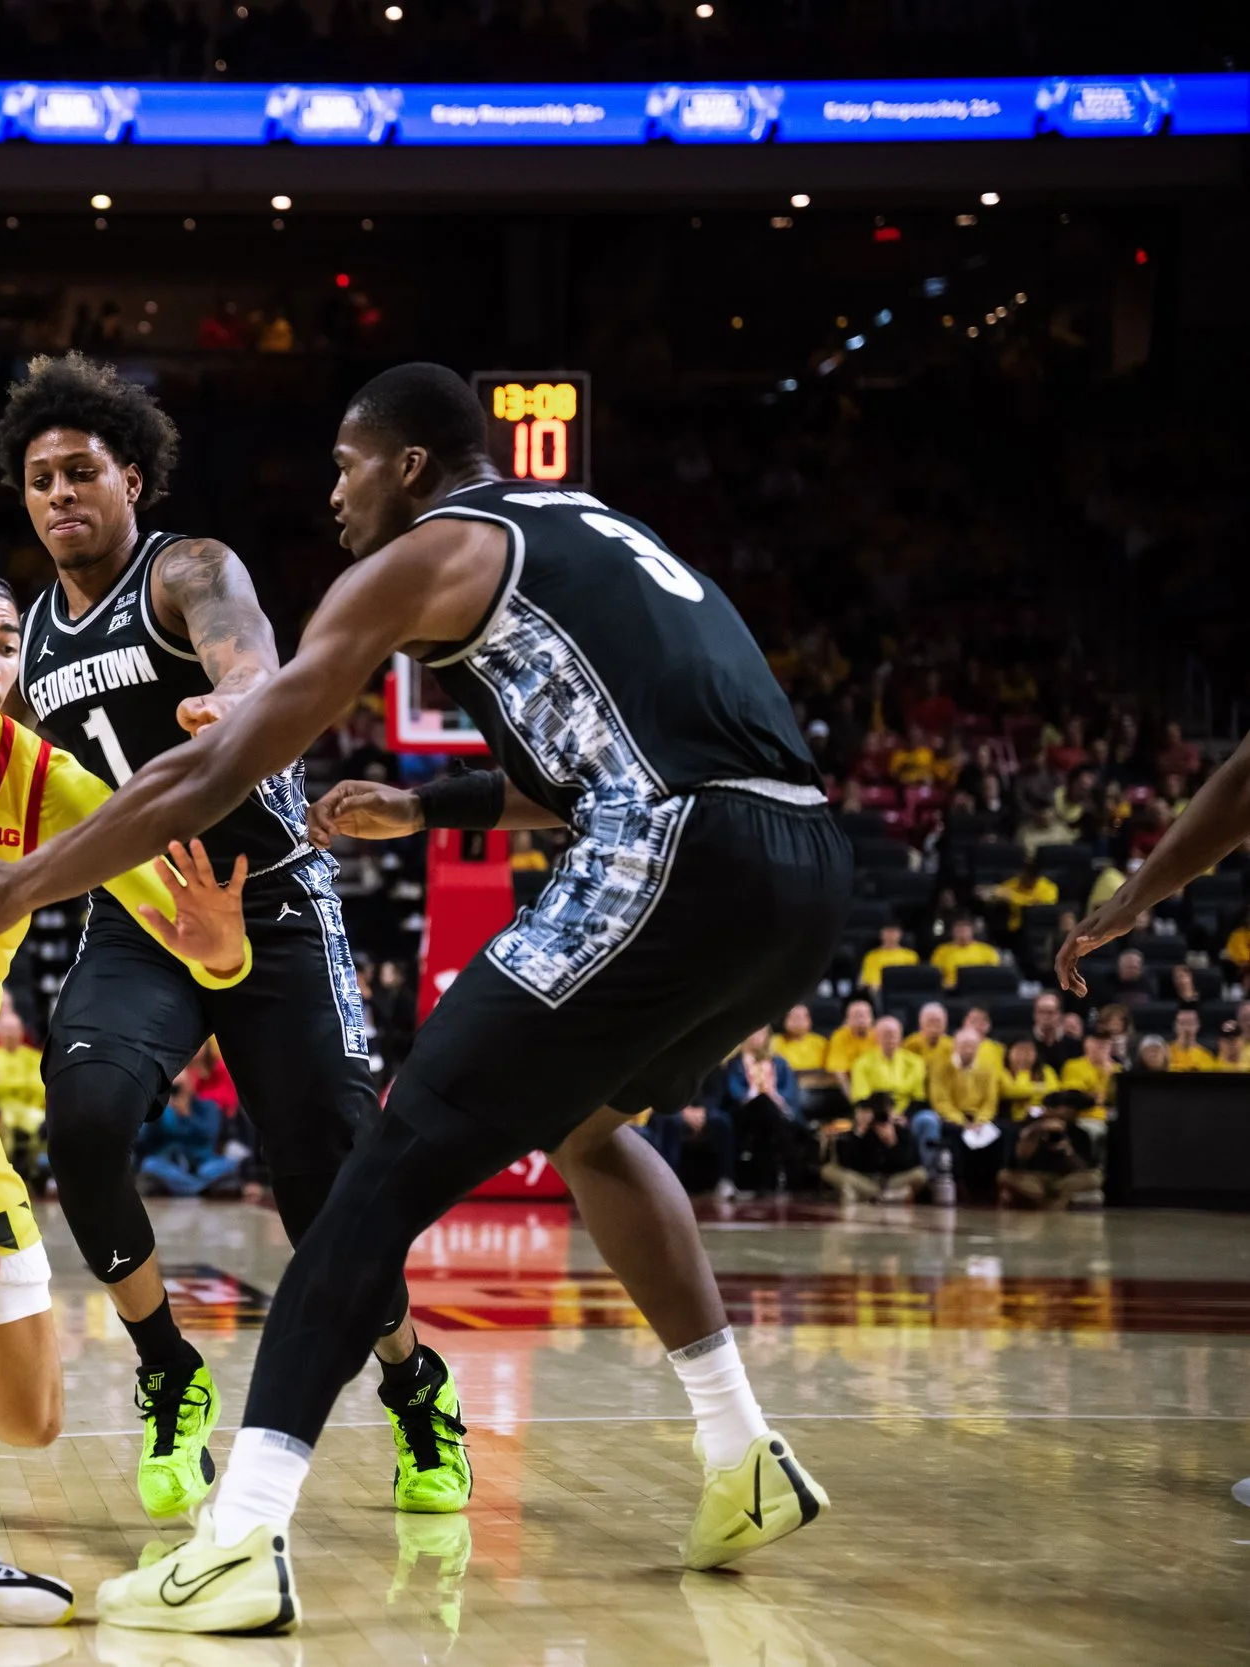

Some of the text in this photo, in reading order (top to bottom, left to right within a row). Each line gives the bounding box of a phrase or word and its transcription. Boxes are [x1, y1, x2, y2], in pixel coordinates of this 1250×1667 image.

[493, 383, 577, 421] 13:08
[514, 418, 567, 480] 10
[579, 512, 705, 603] 3
[108, 615, 133, 631] EAST
[111, 610, 129, 622] BIG
[28, 645, 159, 722] GEORGETOWN
[81, 705, 134, 788] 1
